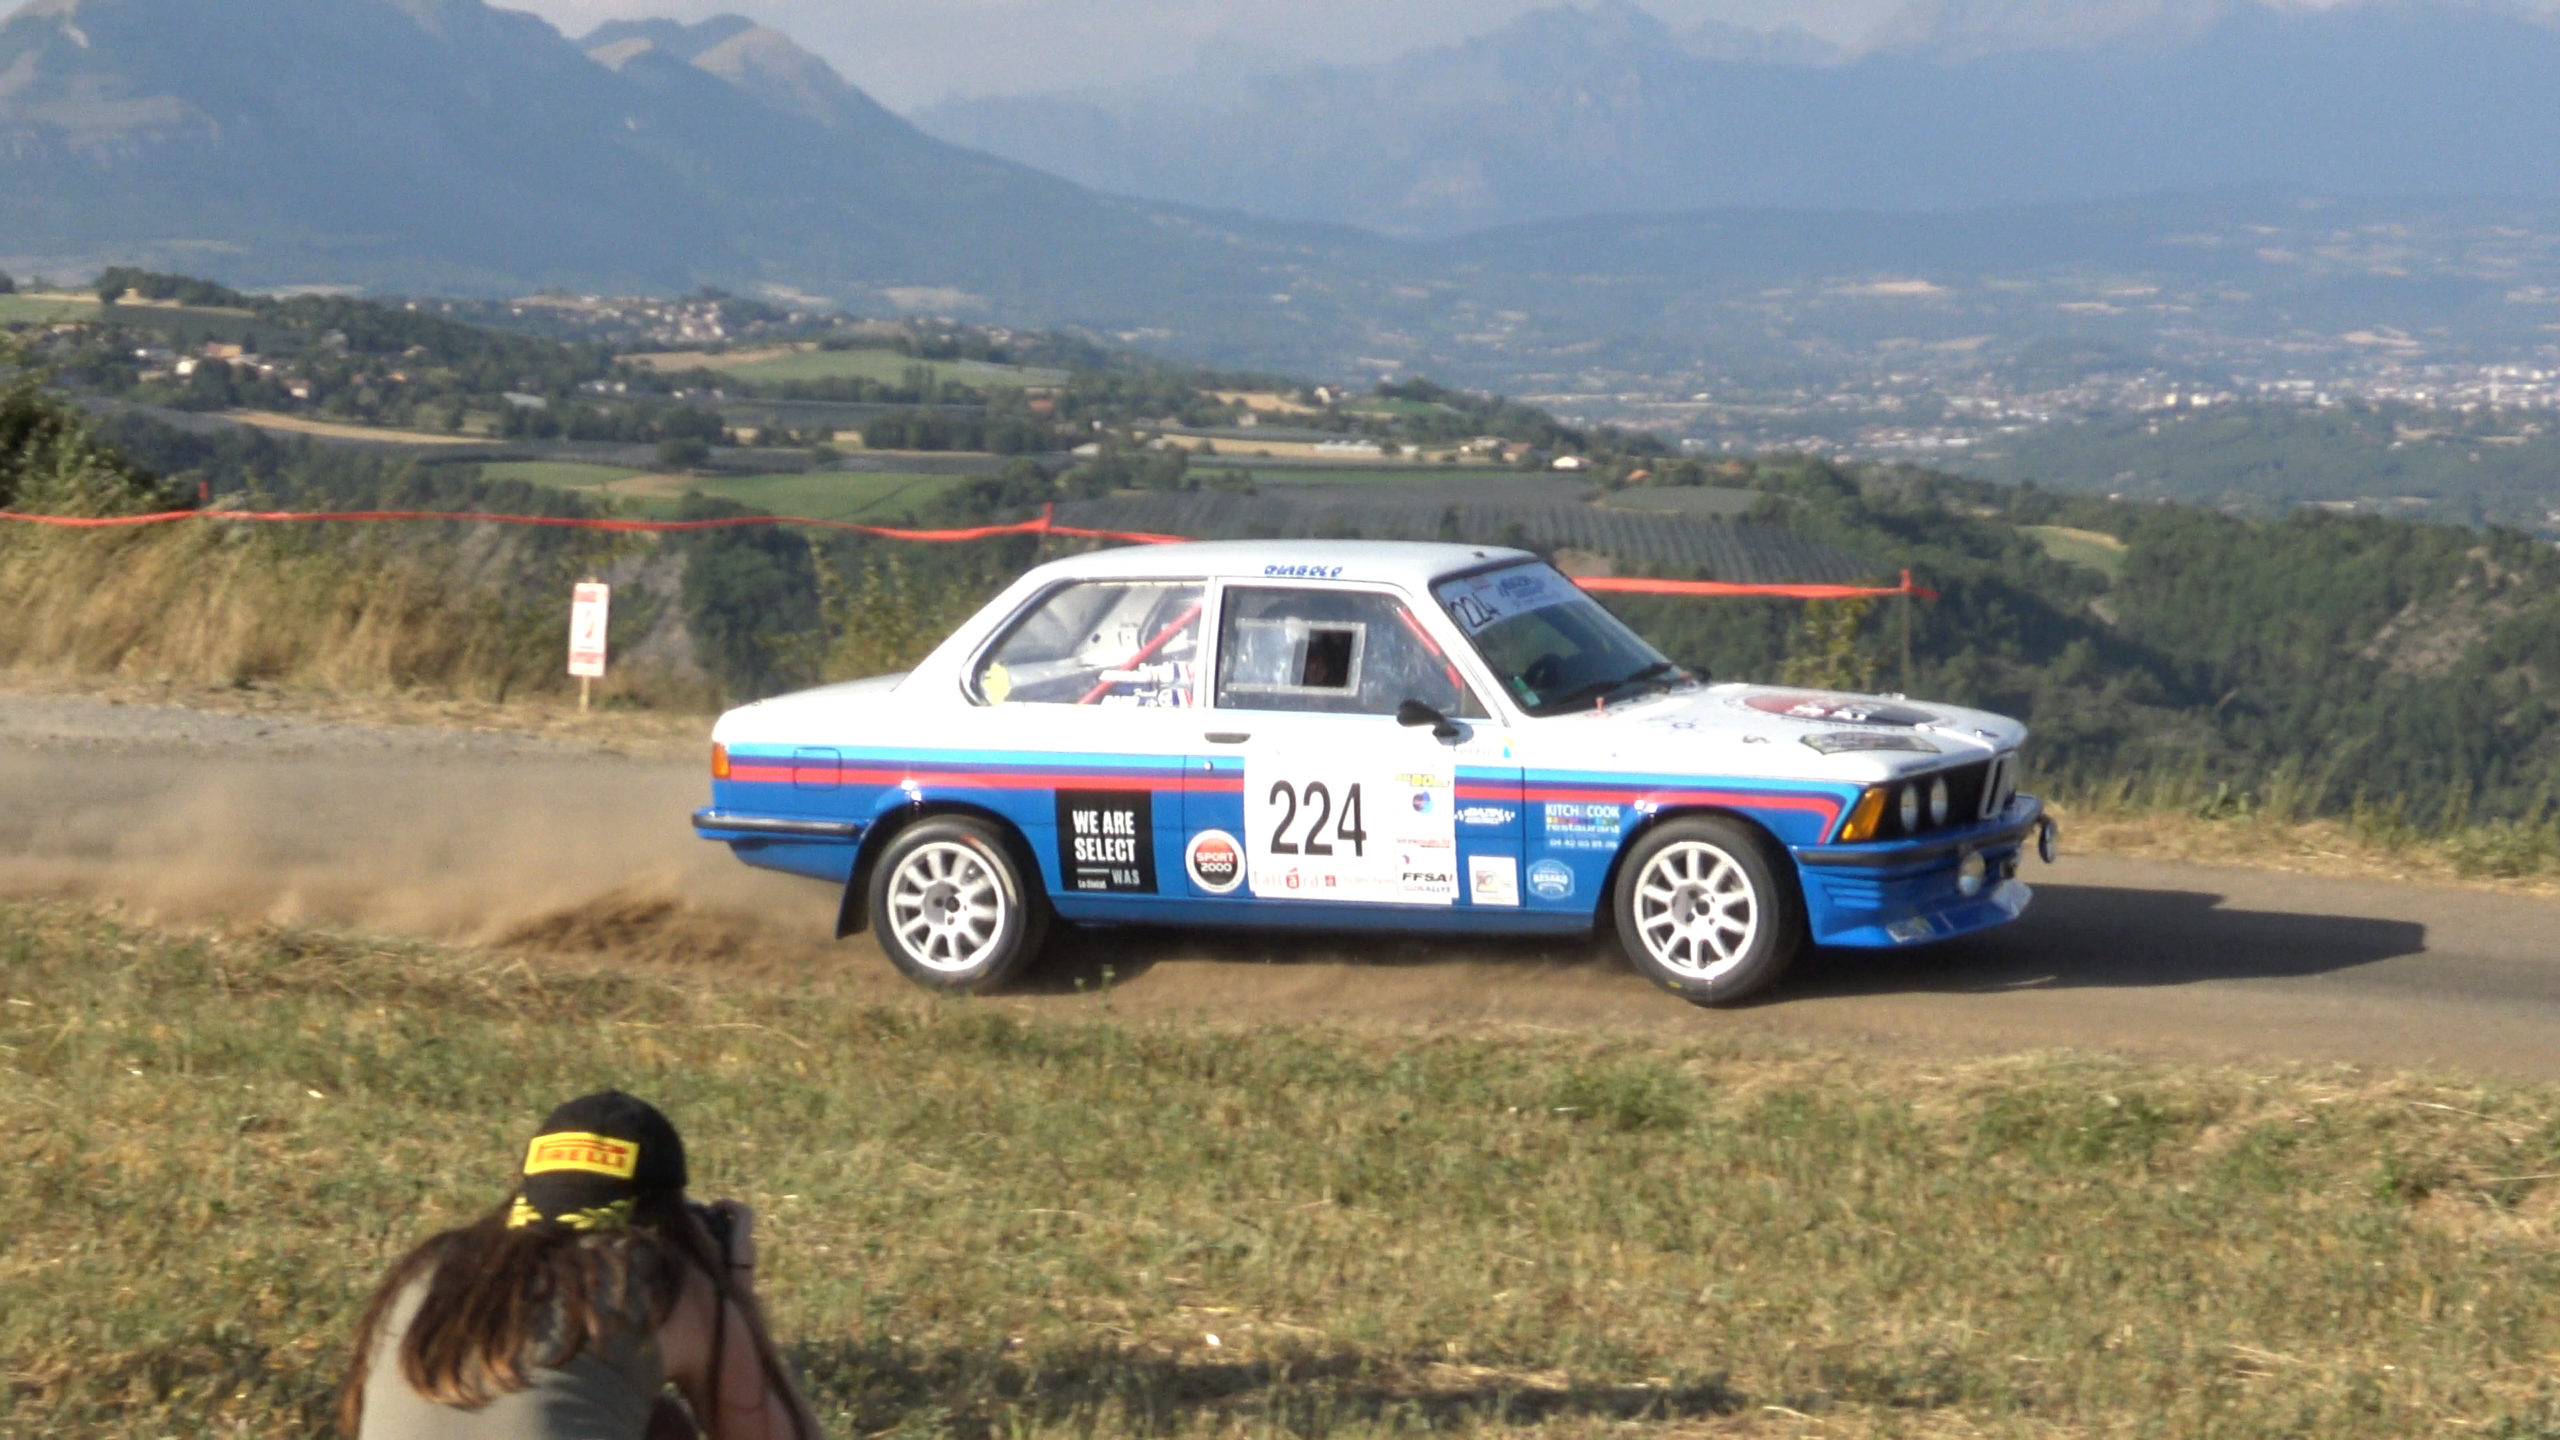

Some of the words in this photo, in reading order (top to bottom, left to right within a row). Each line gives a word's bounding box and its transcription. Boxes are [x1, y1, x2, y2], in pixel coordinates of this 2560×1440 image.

[1072, 810, 1099, 834] WE
[1102, 811, 1136, 835] ARE
[1268, 779, 1367, 857] 224
[1545, 824, 1620, 833] restaurant
[1074, 837, 1136, 862] SELECT
[1196, 852, 1234, 862] SPORT
[1201, 863, 1233, 873] 2000
[1111, 869, 1140, 885] WAS
[1402, 872, 1447, 882] FFSA
[535, 1139, 629, 1169] PIRELLI
